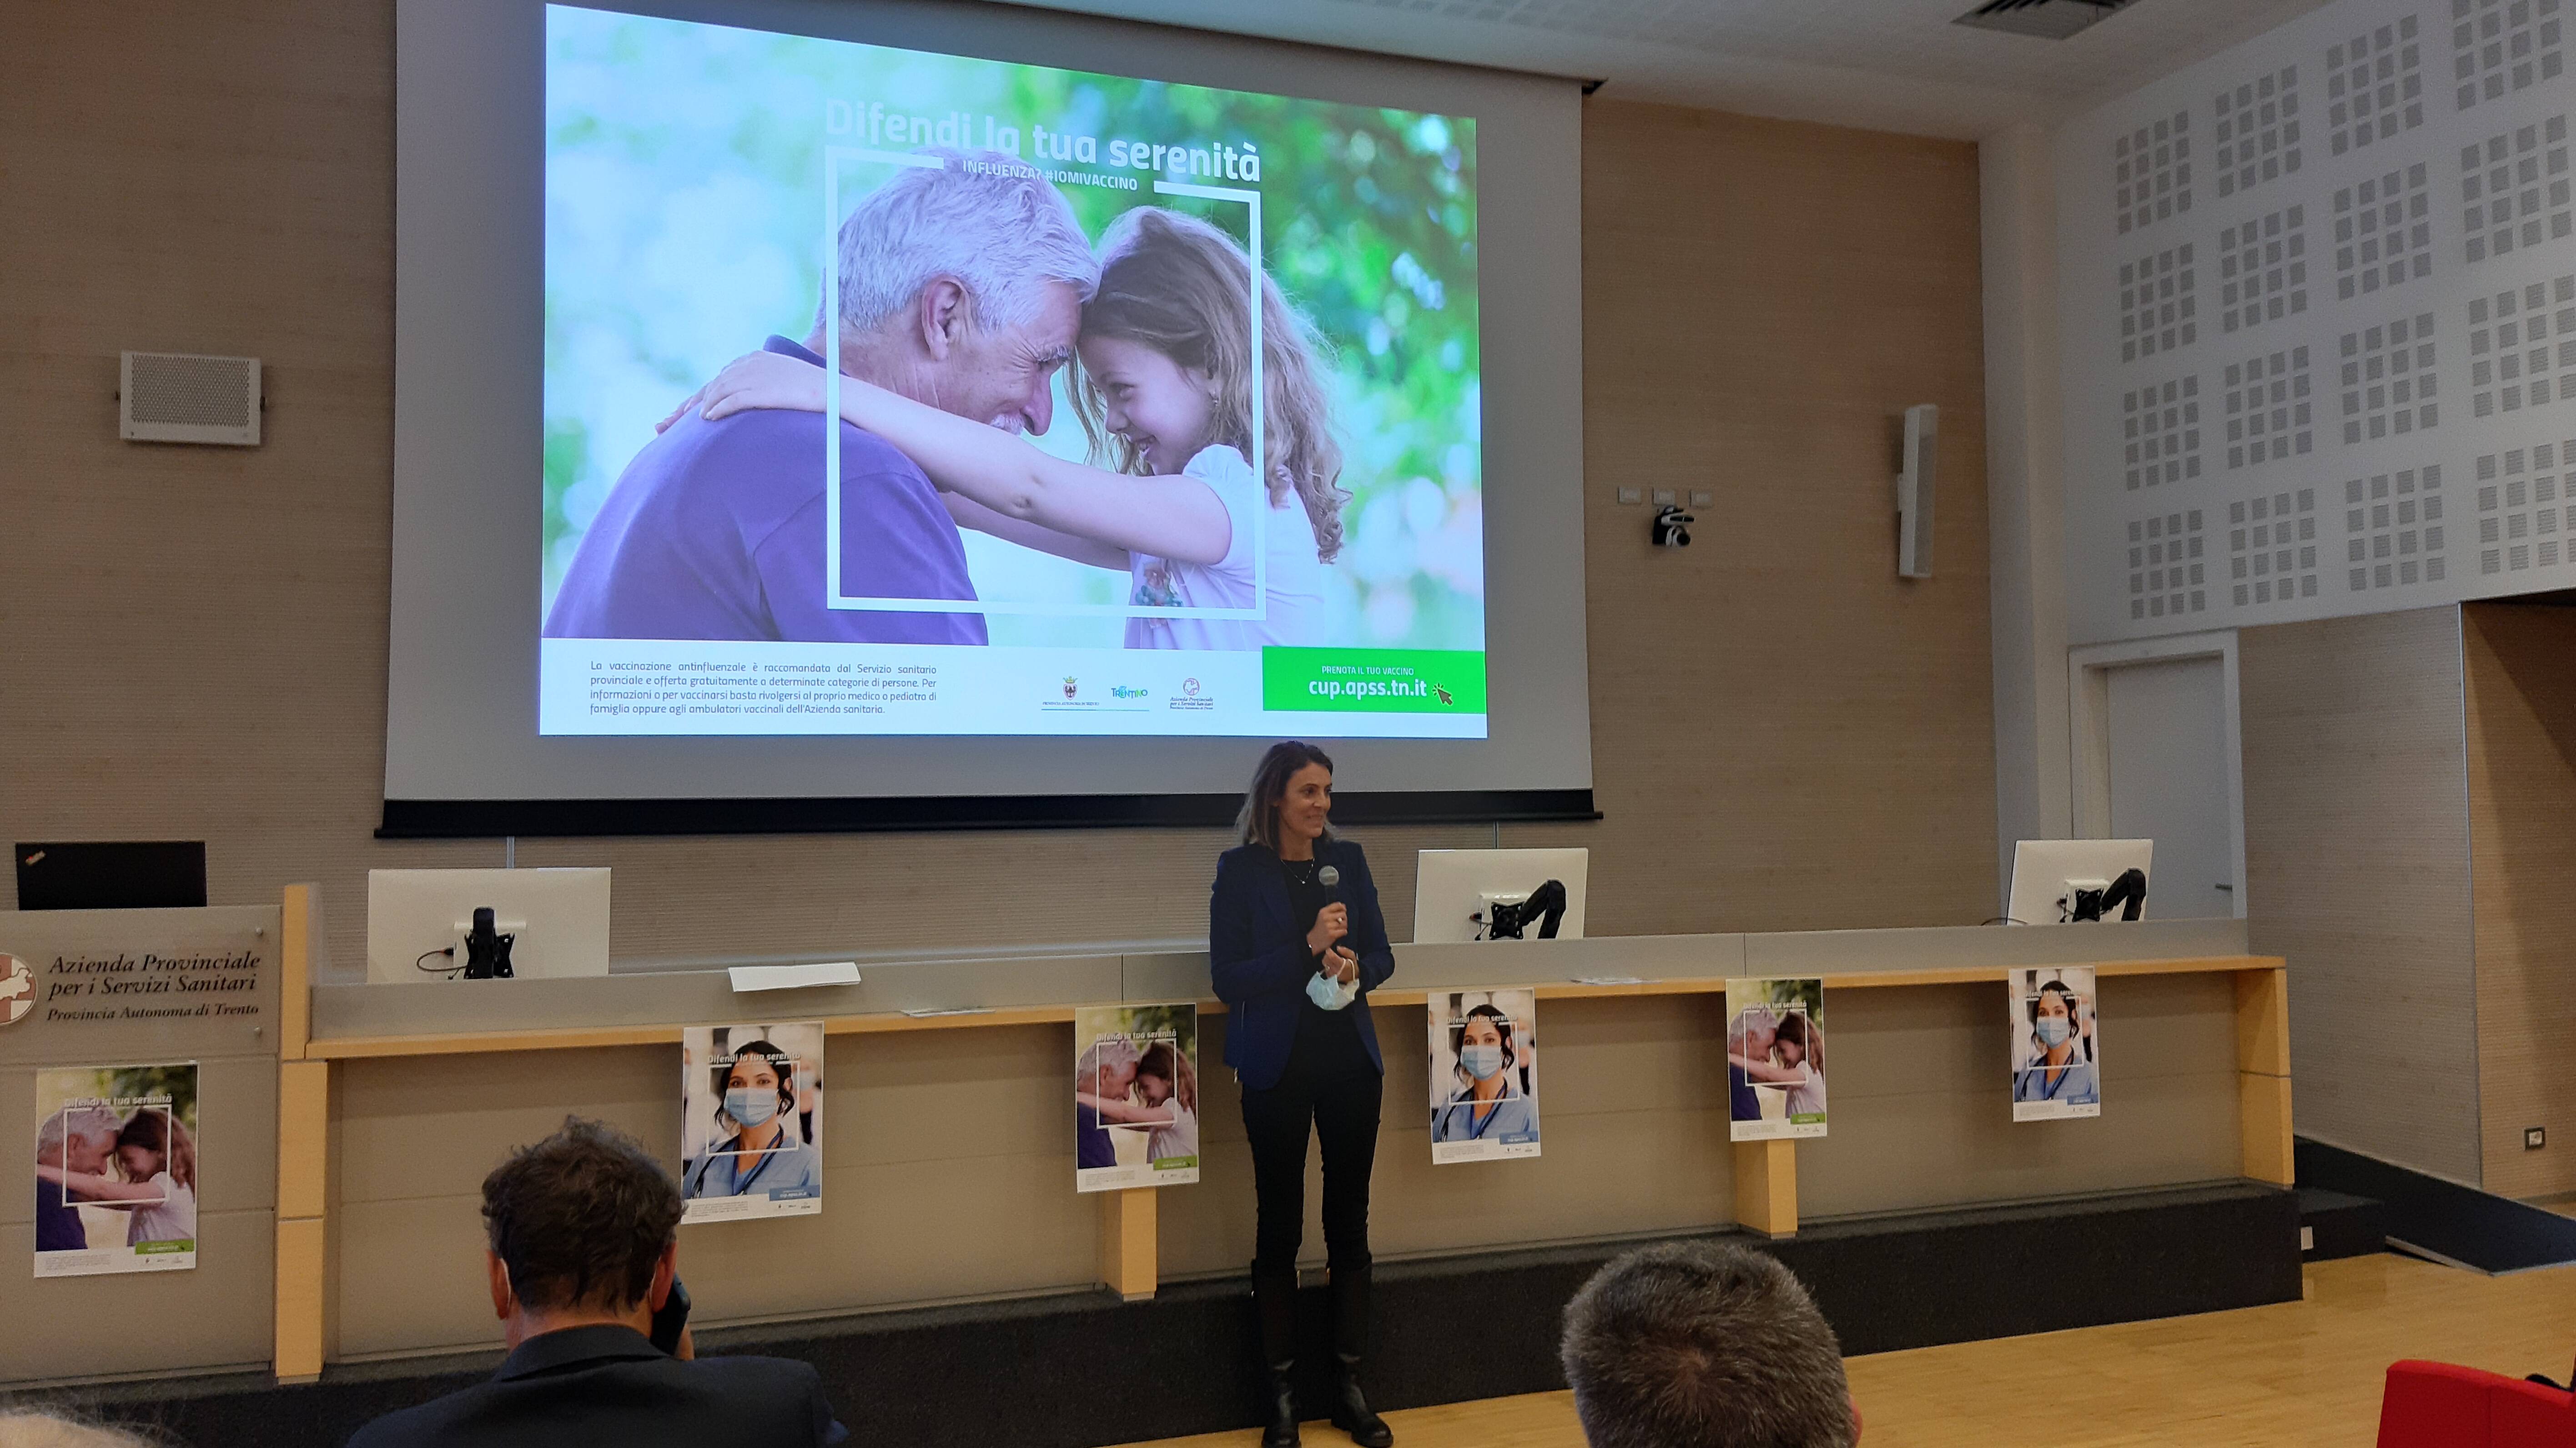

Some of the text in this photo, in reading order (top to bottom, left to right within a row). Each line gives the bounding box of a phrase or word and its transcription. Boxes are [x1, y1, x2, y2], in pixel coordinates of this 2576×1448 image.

[826, 97, 1261, 182] Difendi la tua serenità
[962, 160, 1137, 191] INFLUENZA? #IOMIVACCINO
[591, 661, 936, 674] La vaccinazione antinfluenzale è raccomandata dal Servizio sanitario
[1322, 665, 1414, 676] PRENOTA IL TUO VACCINO
[590, 675, 643, 687] provinciale
[654, 676, 687, 687] offerta
[690, 676, 758, 688] gratuitamente
[769, 677, 825, 686] determinate
[828, 678, 869, 689] categorie
[871, 678, 880, 687] di
[882, 680, 919, 689] persone.
[922, 679, 936, 687] Per
[1308, 678, 1428, 701] cup.apss.tn.it
[590, 689, 652, 701] informazioni
[662, 691, 678, 701] per
[680, 690, 727, 699] vaccinarsi
[730, 690, 756, 700] basta
[759, 690, 800, 702] rivolgersi
[803, 691, 811, 700] al
[814, 691, 846, 702] proprio
[848, 691, 880, 700] medico
[890, 691, 926, 703] pediatra
[929, 692, 936, 701] di
[590, 703, 885, 715] famiglia oppure agli ambulatori vaccinali dell'Azienda sanitaria.
[49, 950, 261, 973] Azienda Provinciale
[48, 974, 257, 1001] per i Servizi Sanitari
[47, 1002, 259, 1021] Provincia Autonoma di Trento
[740, 1053, 748, 1062] la
